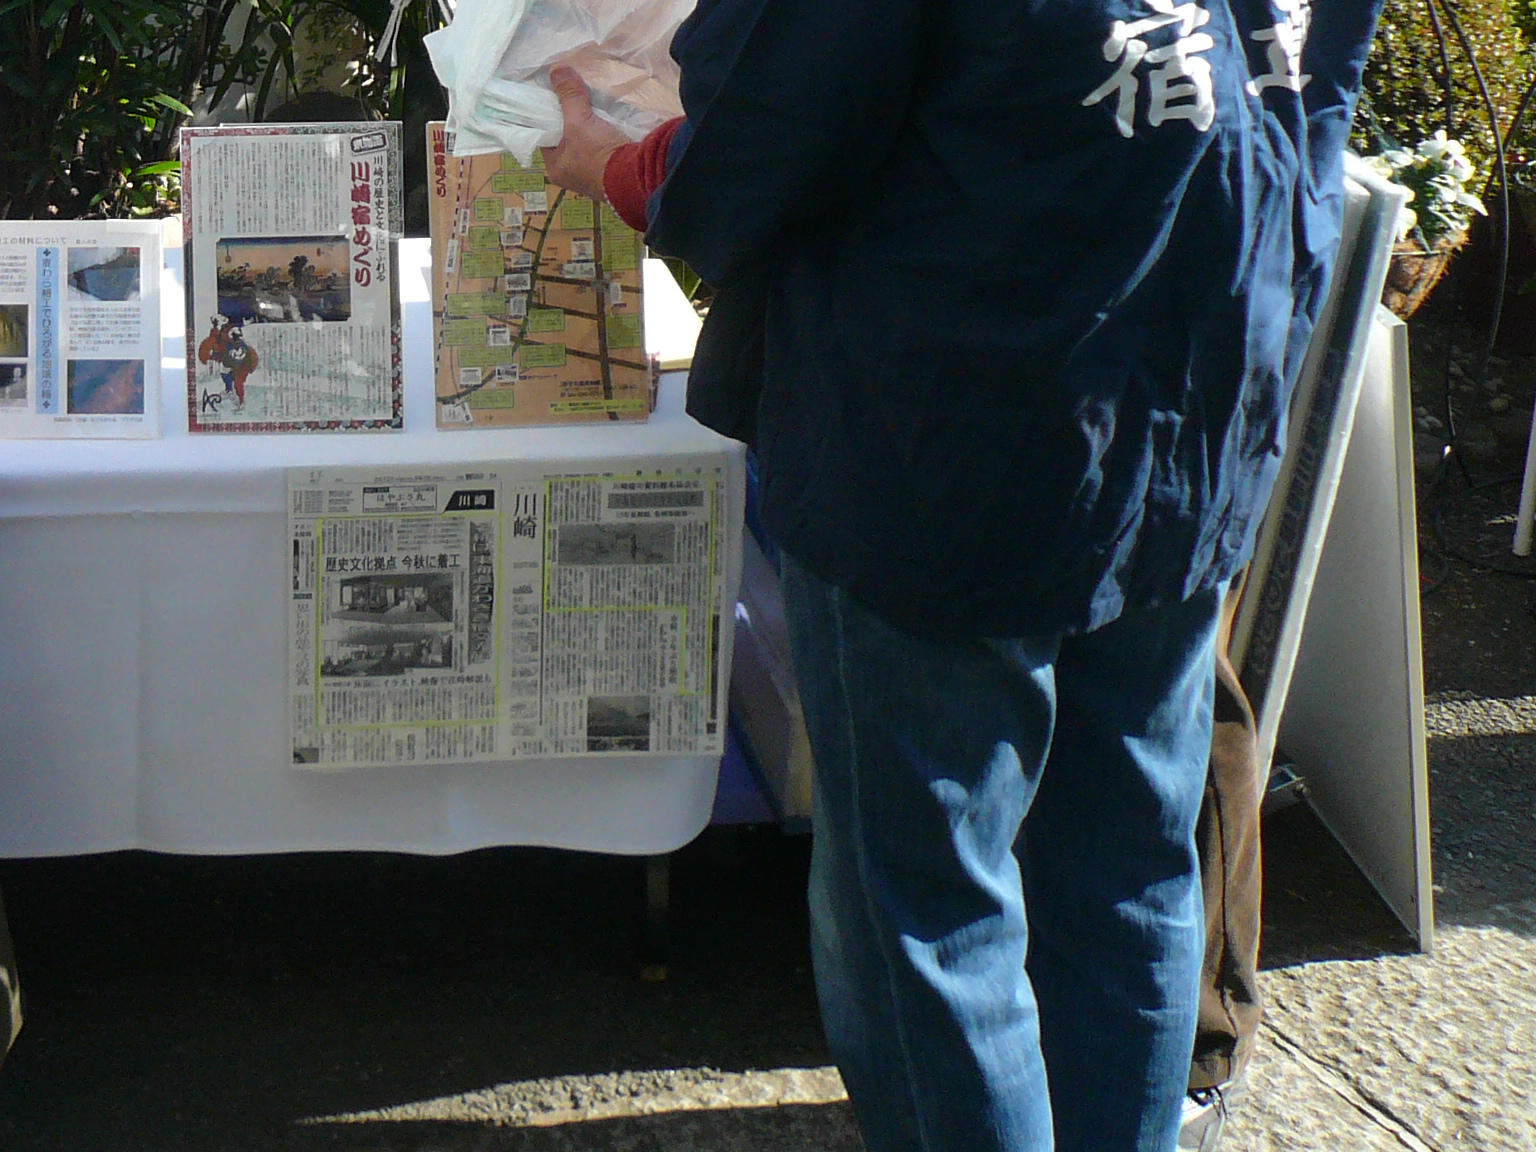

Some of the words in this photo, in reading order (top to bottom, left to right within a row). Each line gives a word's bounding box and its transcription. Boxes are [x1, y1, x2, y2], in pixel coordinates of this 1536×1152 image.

[350, 161, 373, 288] 川崎宿めぐり
[514, 493, 537, 539] 川崎
[325, 556, 397, 573] 歴史文化拠点
